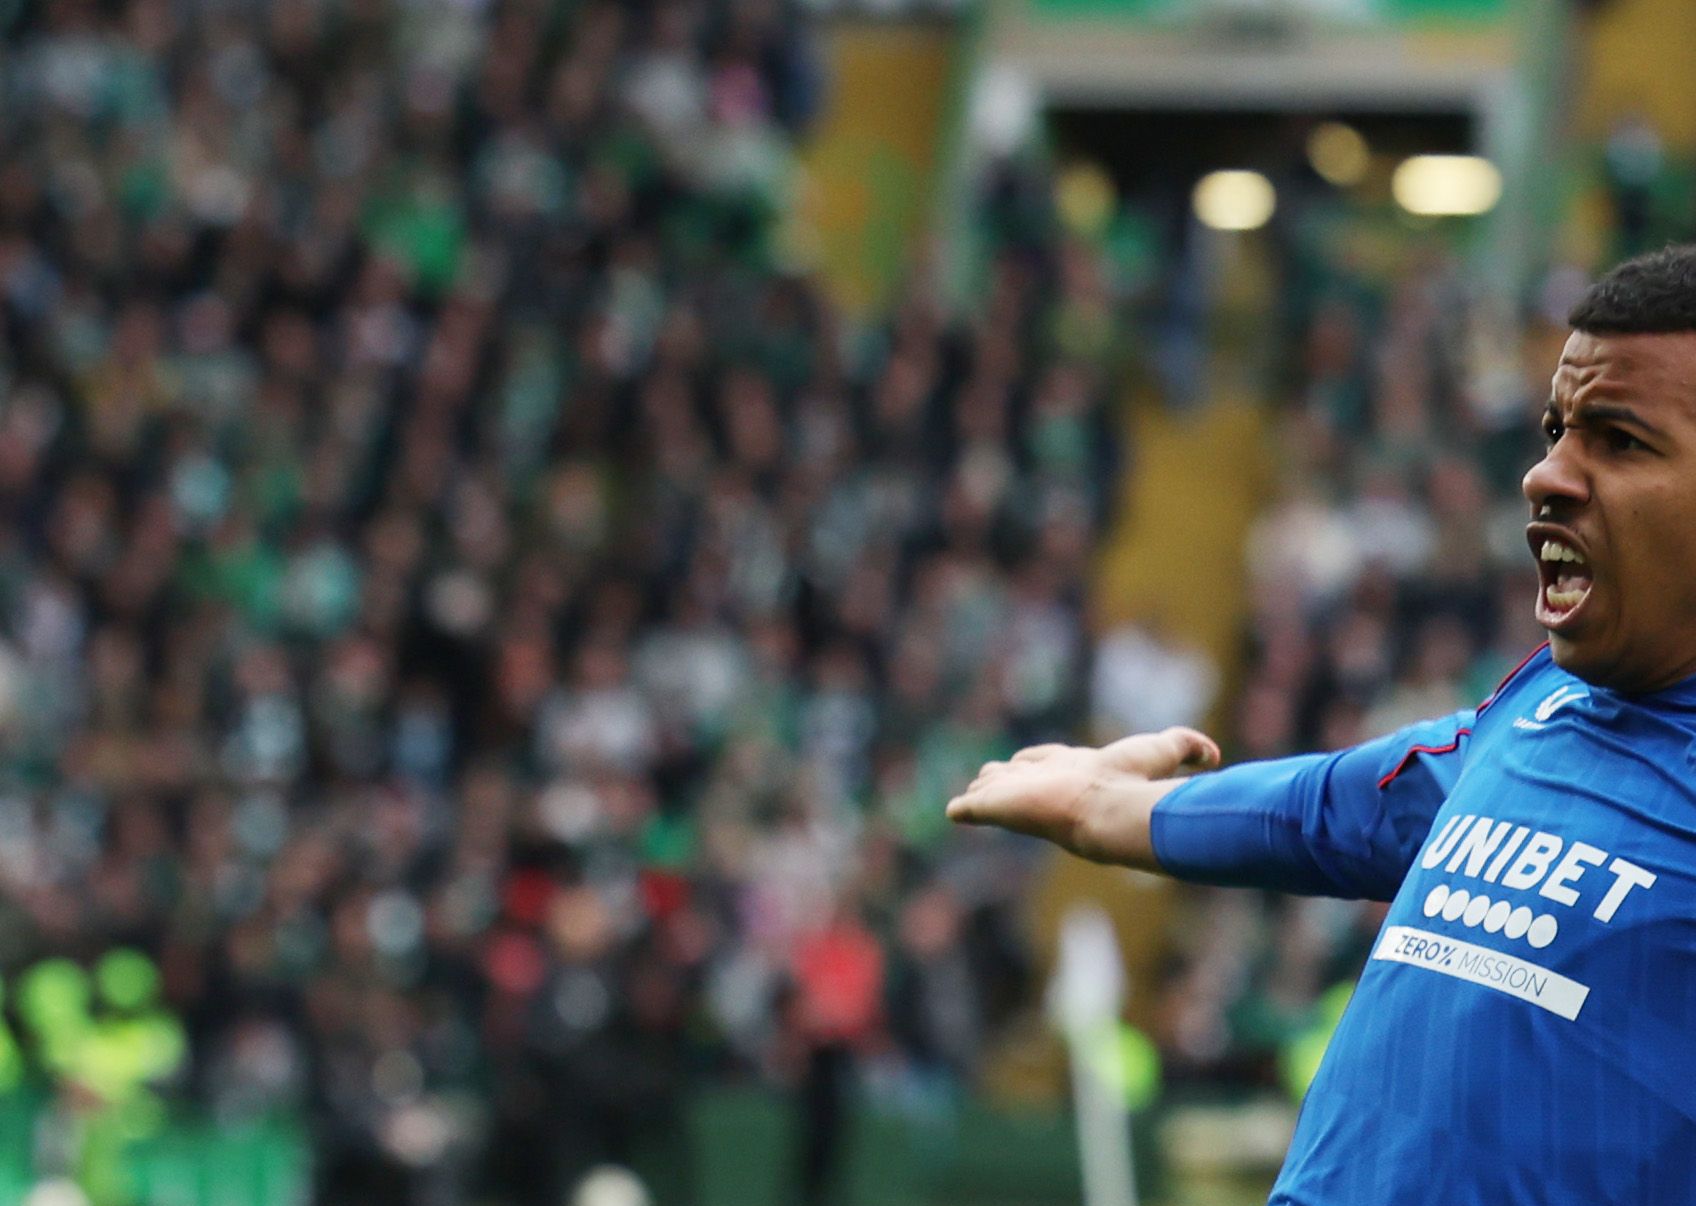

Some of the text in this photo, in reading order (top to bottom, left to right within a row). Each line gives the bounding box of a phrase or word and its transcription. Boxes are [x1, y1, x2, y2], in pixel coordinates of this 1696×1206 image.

[1421, 814, 1657, 924] UNIBET
[1394, 934, 1548, 998] ZERO% MISSION
